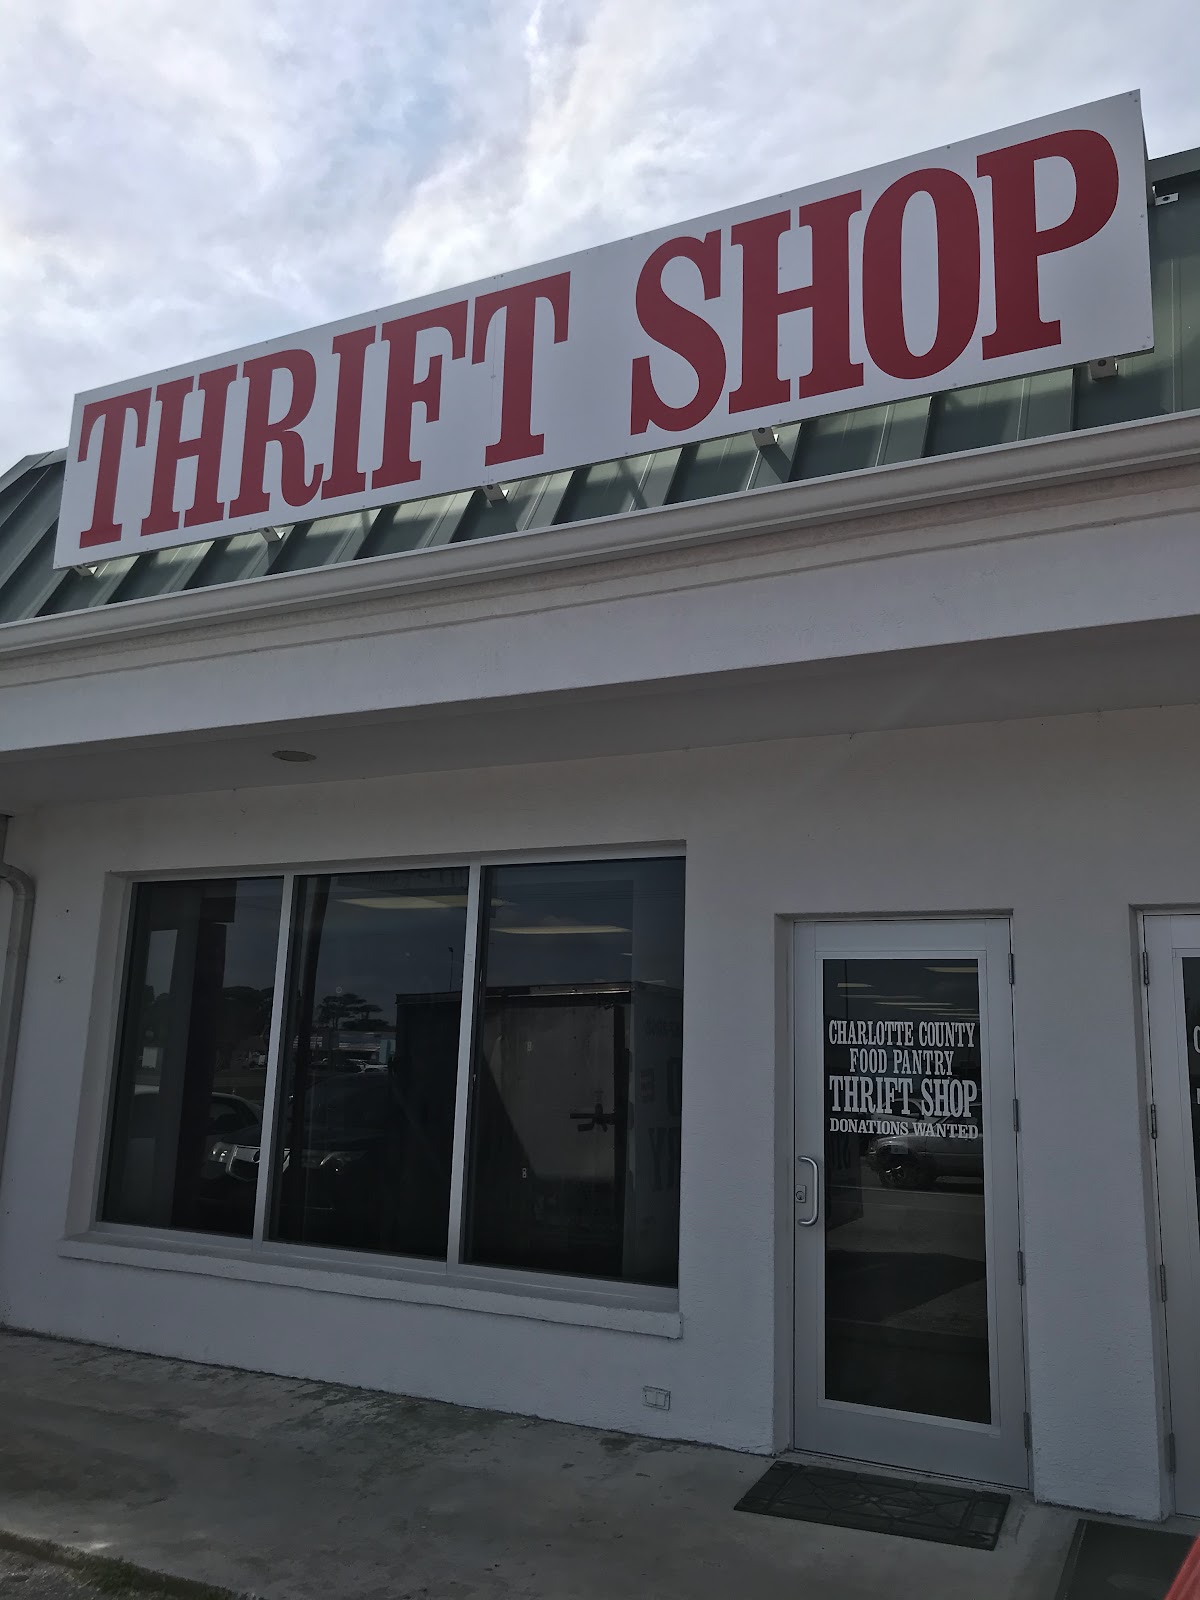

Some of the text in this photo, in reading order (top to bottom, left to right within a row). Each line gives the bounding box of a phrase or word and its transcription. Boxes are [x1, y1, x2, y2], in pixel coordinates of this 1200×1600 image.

[77, 129, 1119, 549] THRIFT SHOP
[829, 1020, 975, 1048] CHARLOTTE COUNTY
[850, 1048, 954, 1076] FOOD PANTRY
[829, 1075, 978, 1118] THRIFT SHOP
[829, 1118, 979, 1139] DONATIONS WANTED
